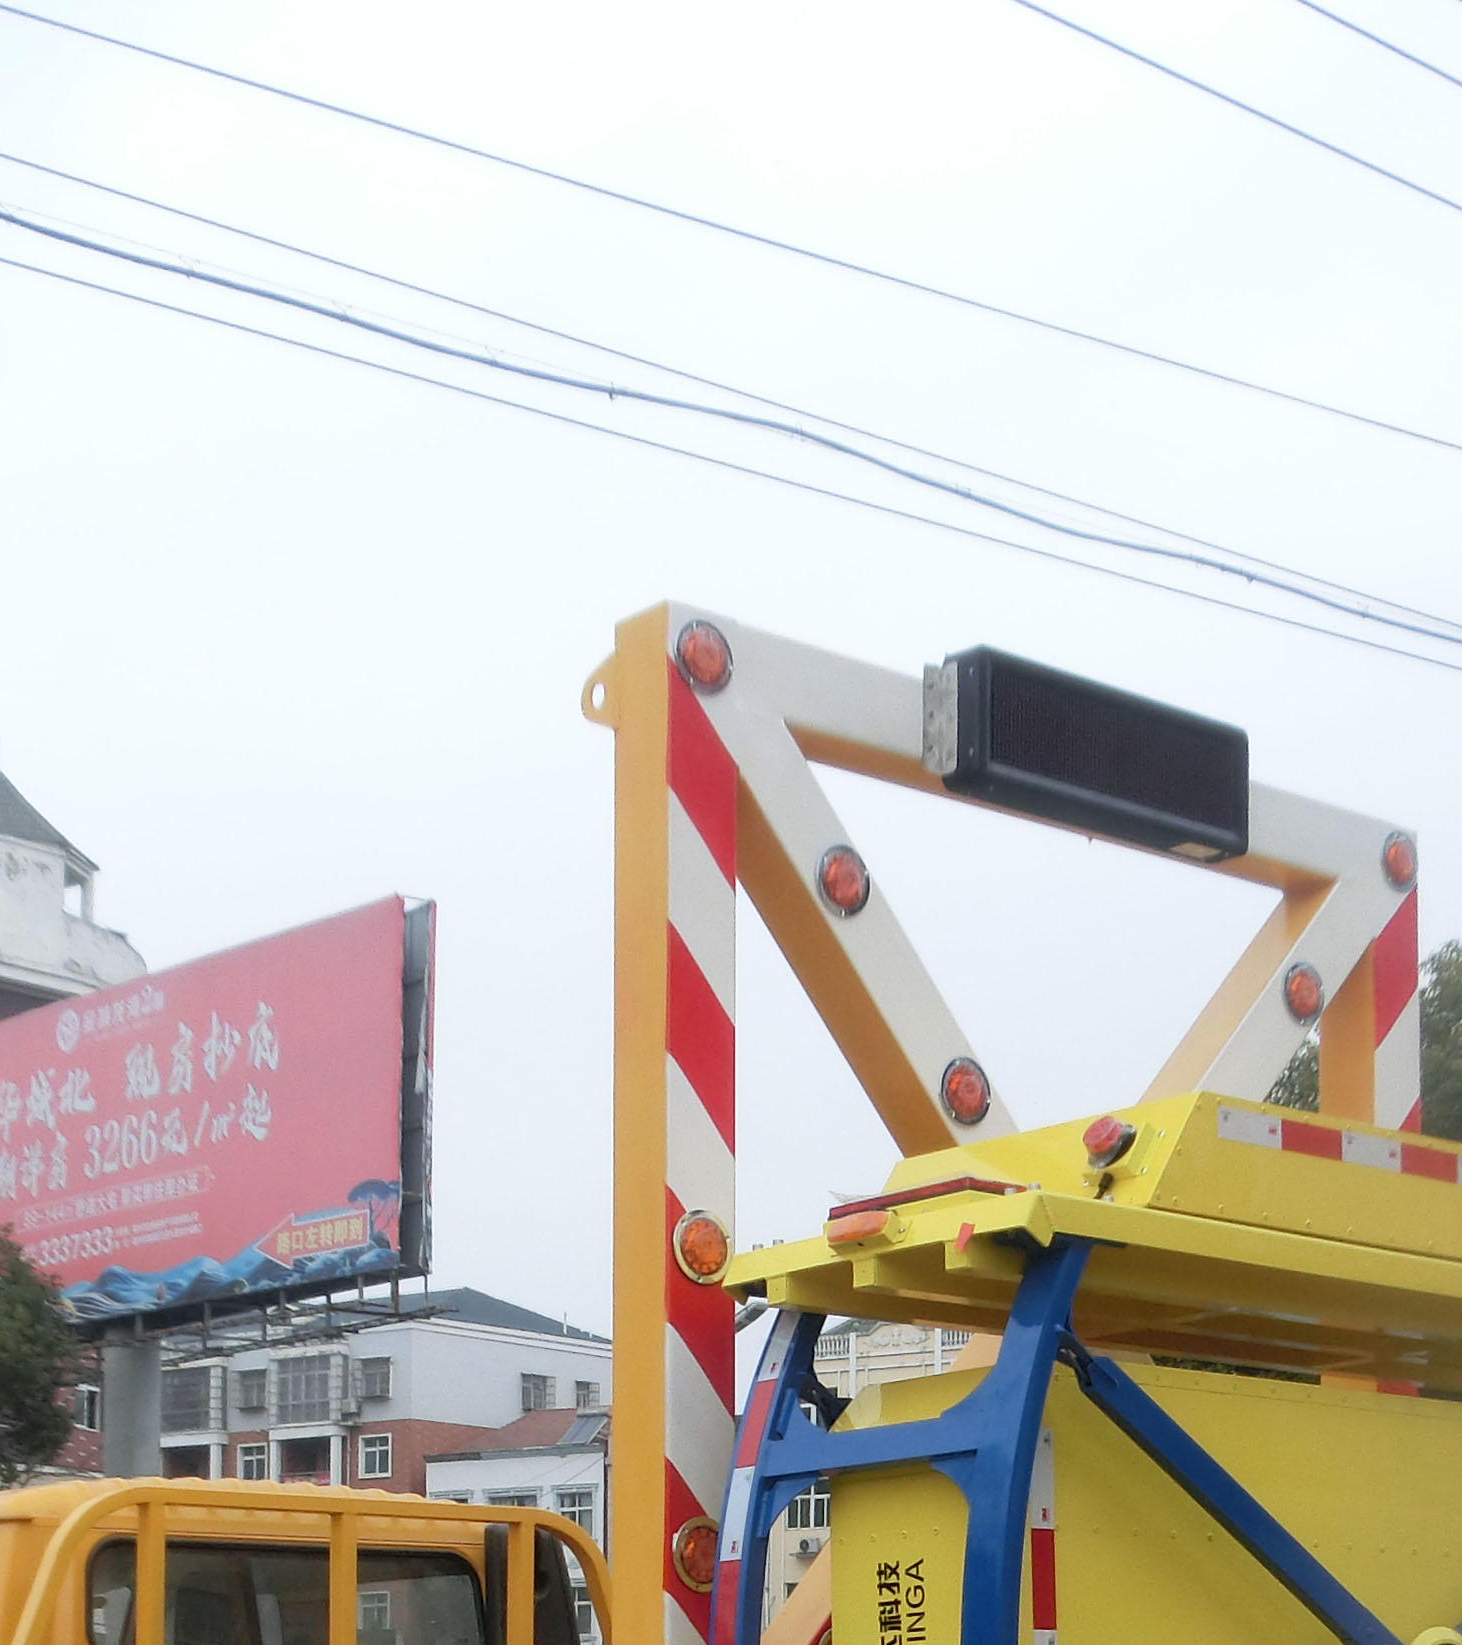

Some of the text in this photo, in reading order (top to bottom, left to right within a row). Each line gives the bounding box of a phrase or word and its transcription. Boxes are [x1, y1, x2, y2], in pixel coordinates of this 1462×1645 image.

[276, 1217, 363, 1256] 路口左转即到
